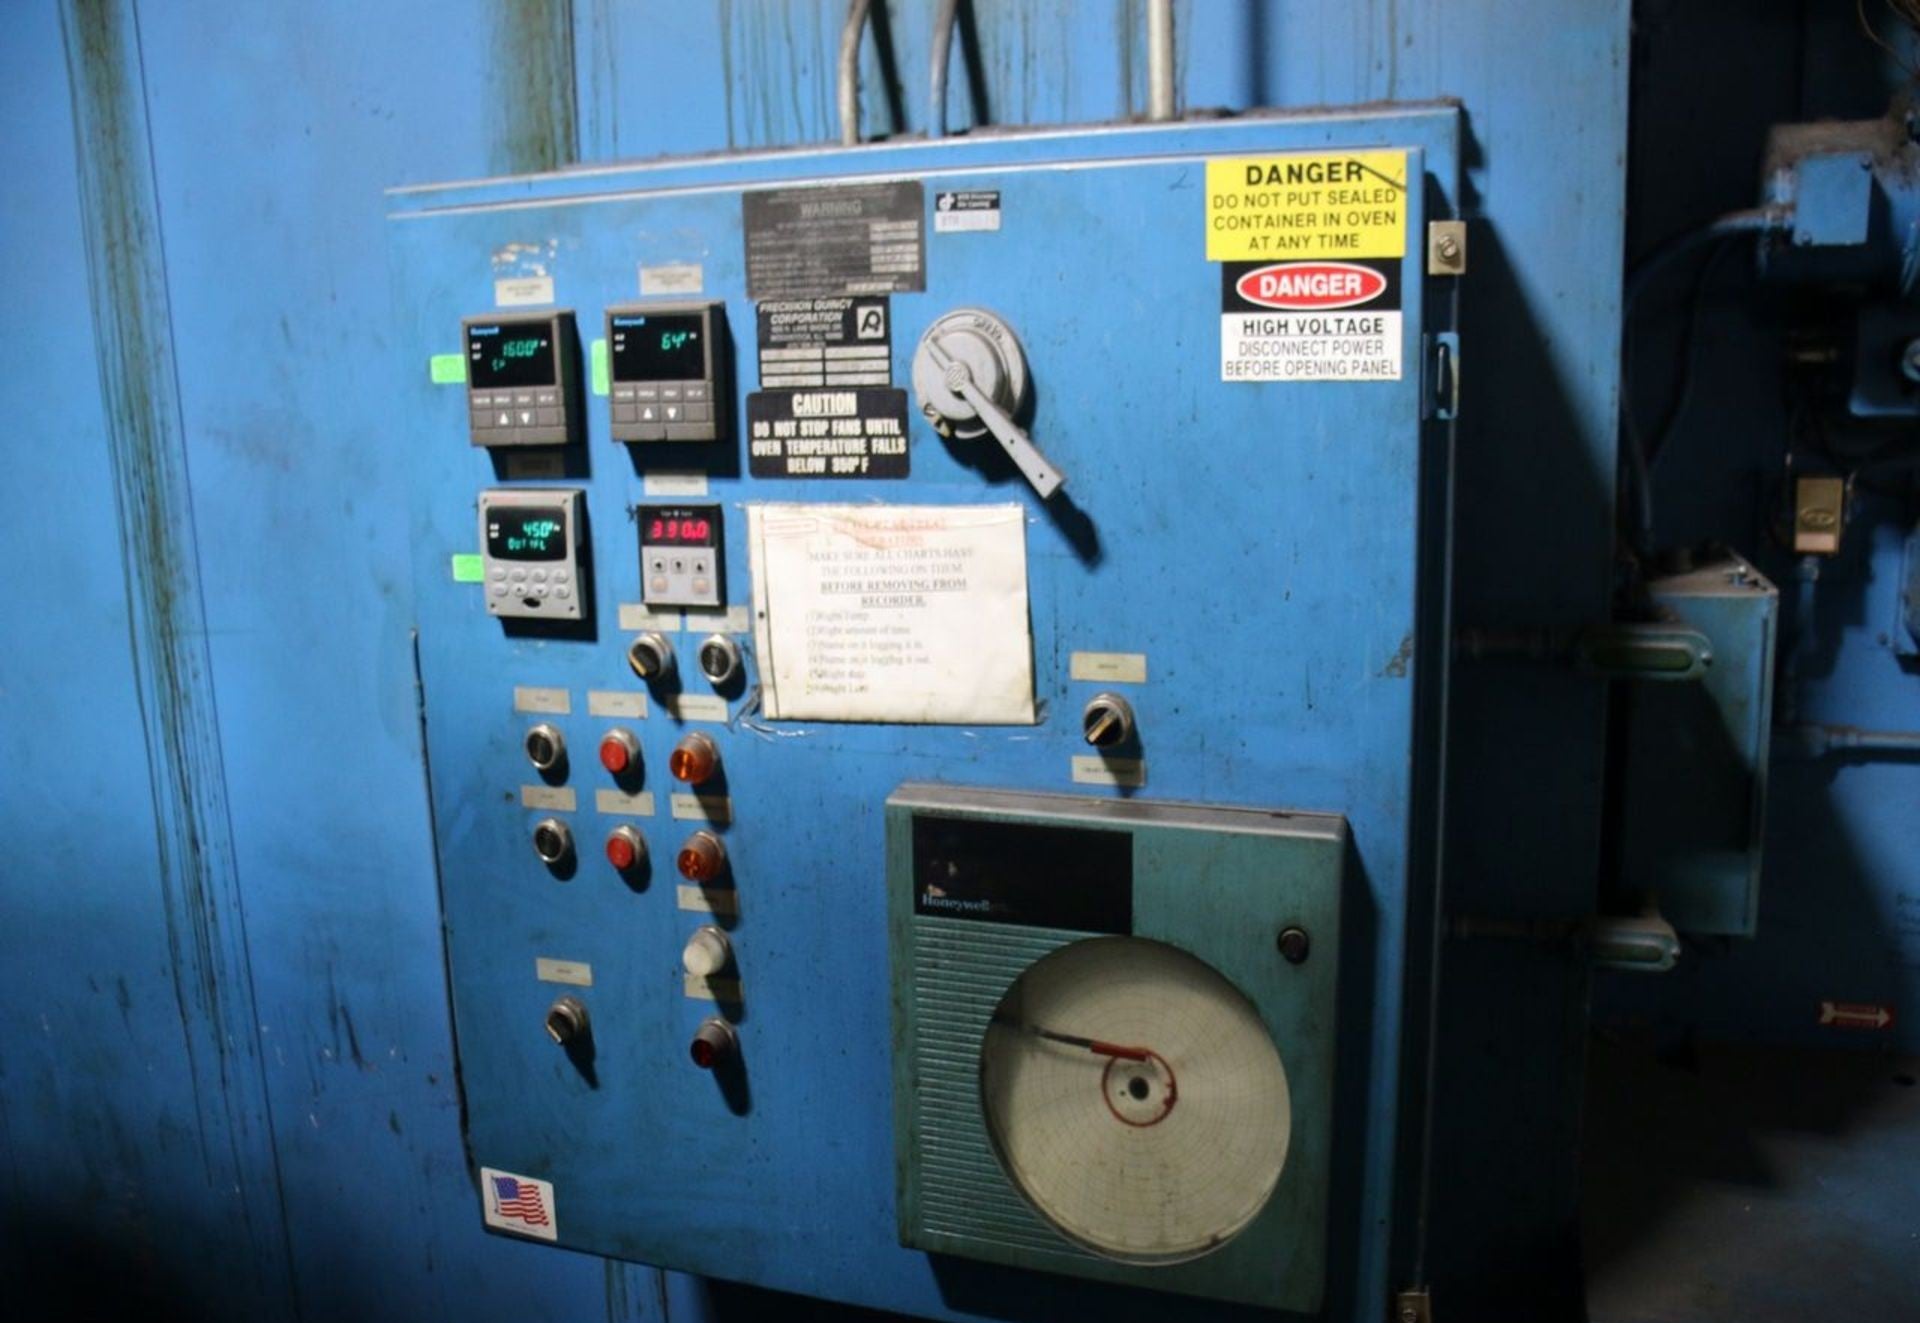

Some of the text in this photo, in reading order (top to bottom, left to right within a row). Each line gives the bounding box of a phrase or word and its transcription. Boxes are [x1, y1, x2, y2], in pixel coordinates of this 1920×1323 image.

[1246, 161, 1363, 185] DANGER
[1213, 189, 1397, 209] DO NOT PUT SEALED
[801, 199, 862, 218] WARNING
[1214, 210, 1396, 230] CONTAINER IN OVEN
[1249, 233, 1359, 250] AT ANY TIME
[1260, 274, 1362, 297] DANGER
[770, 312, 843, 325] CORPORATION
[1243, 318, 1384, 335] HIGH VOLTAGE
[1239, 339, 1383, 357] DISCONNECT POWER
[1226, 360, 1397, 376] BEFORE OPENING PANEL
[792, 392, 857, 416] CAUTION
[754, 419, 900, 437] DO NOT STOP FANS UNTIL
[752, 438, 906, 456] OVEN TEMPERATURE FALLS
[787, 458, 826, 473] BELOW
[897, 549, 942, 559] CHARTS
[844, 564, 910, 575] FOLLOWING
[820, 577, 967, 593] BEFORE REMOVING FROM
[922, 893, 990, 912] Honeywell
